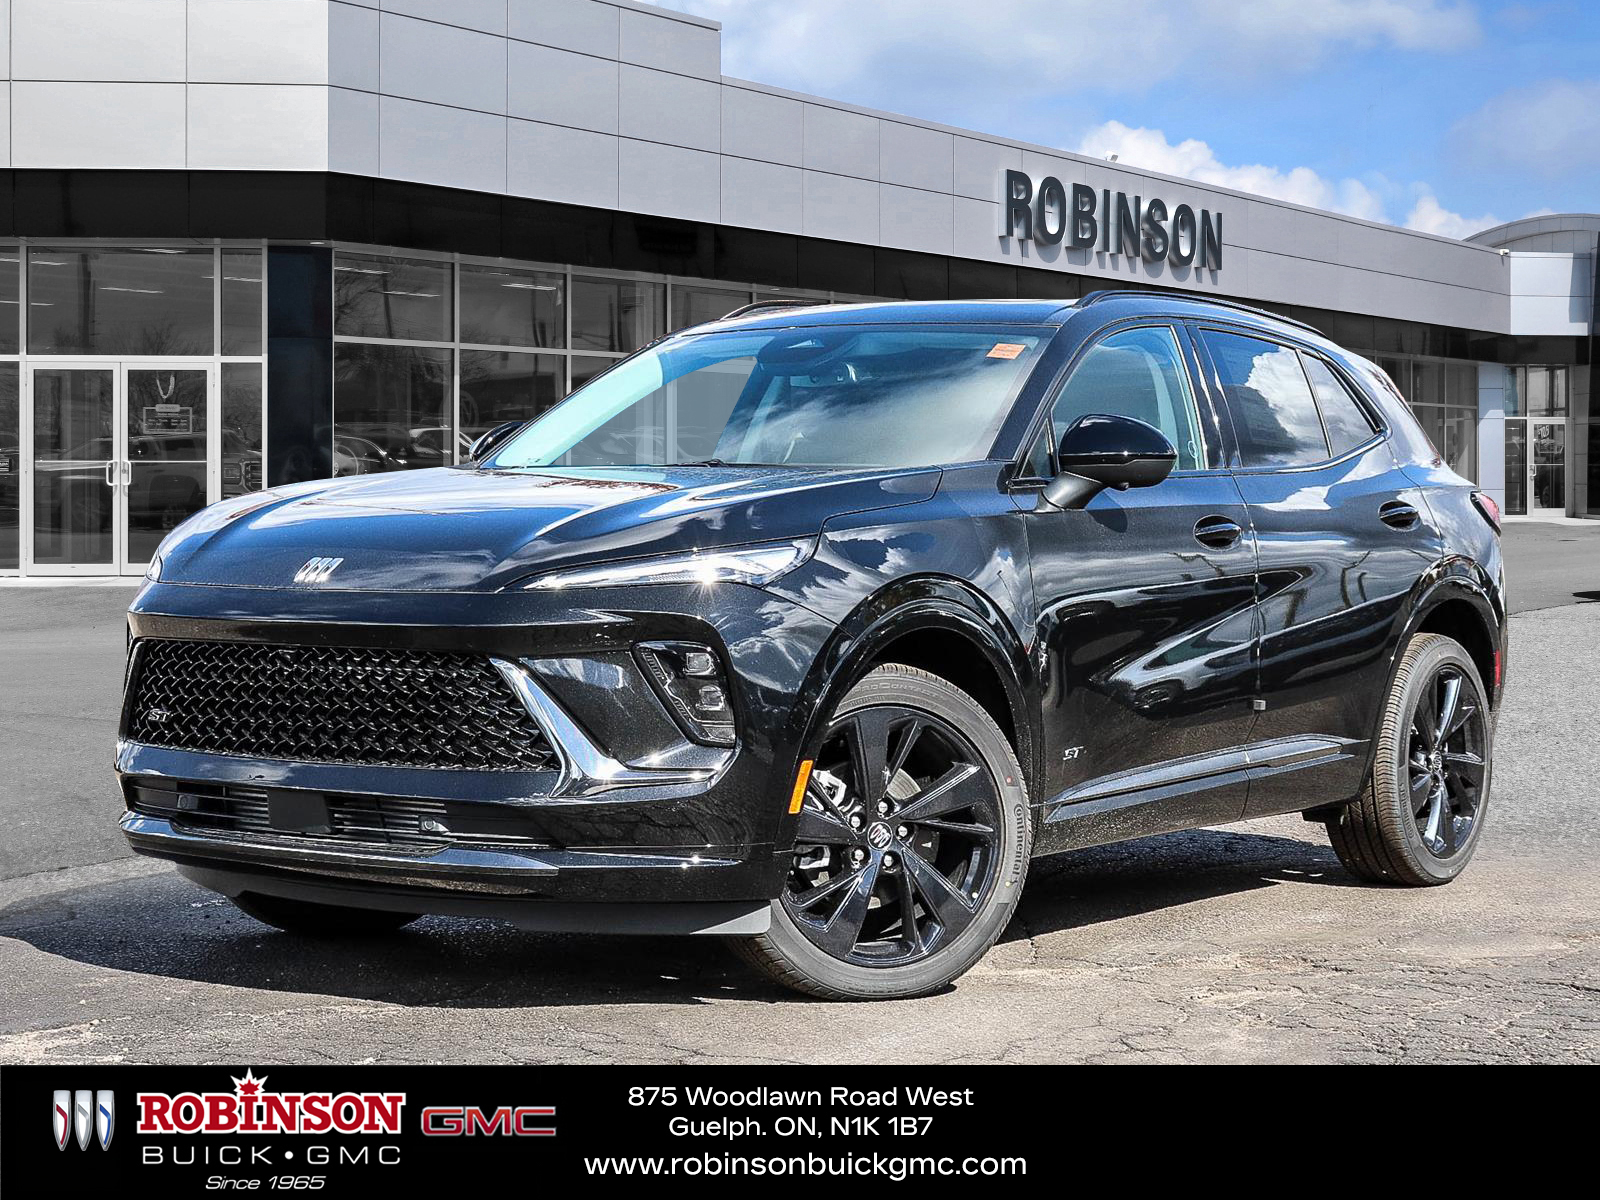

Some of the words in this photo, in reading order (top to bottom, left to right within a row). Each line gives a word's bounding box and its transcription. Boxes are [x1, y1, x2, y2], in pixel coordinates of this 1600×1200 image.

[999, 168, 1222, 271] ROBINSON
[148, 708, 170, 722] ST
[1062, 745, 1084, 761] ST
[1012, 803, 1024, 875] Continental
